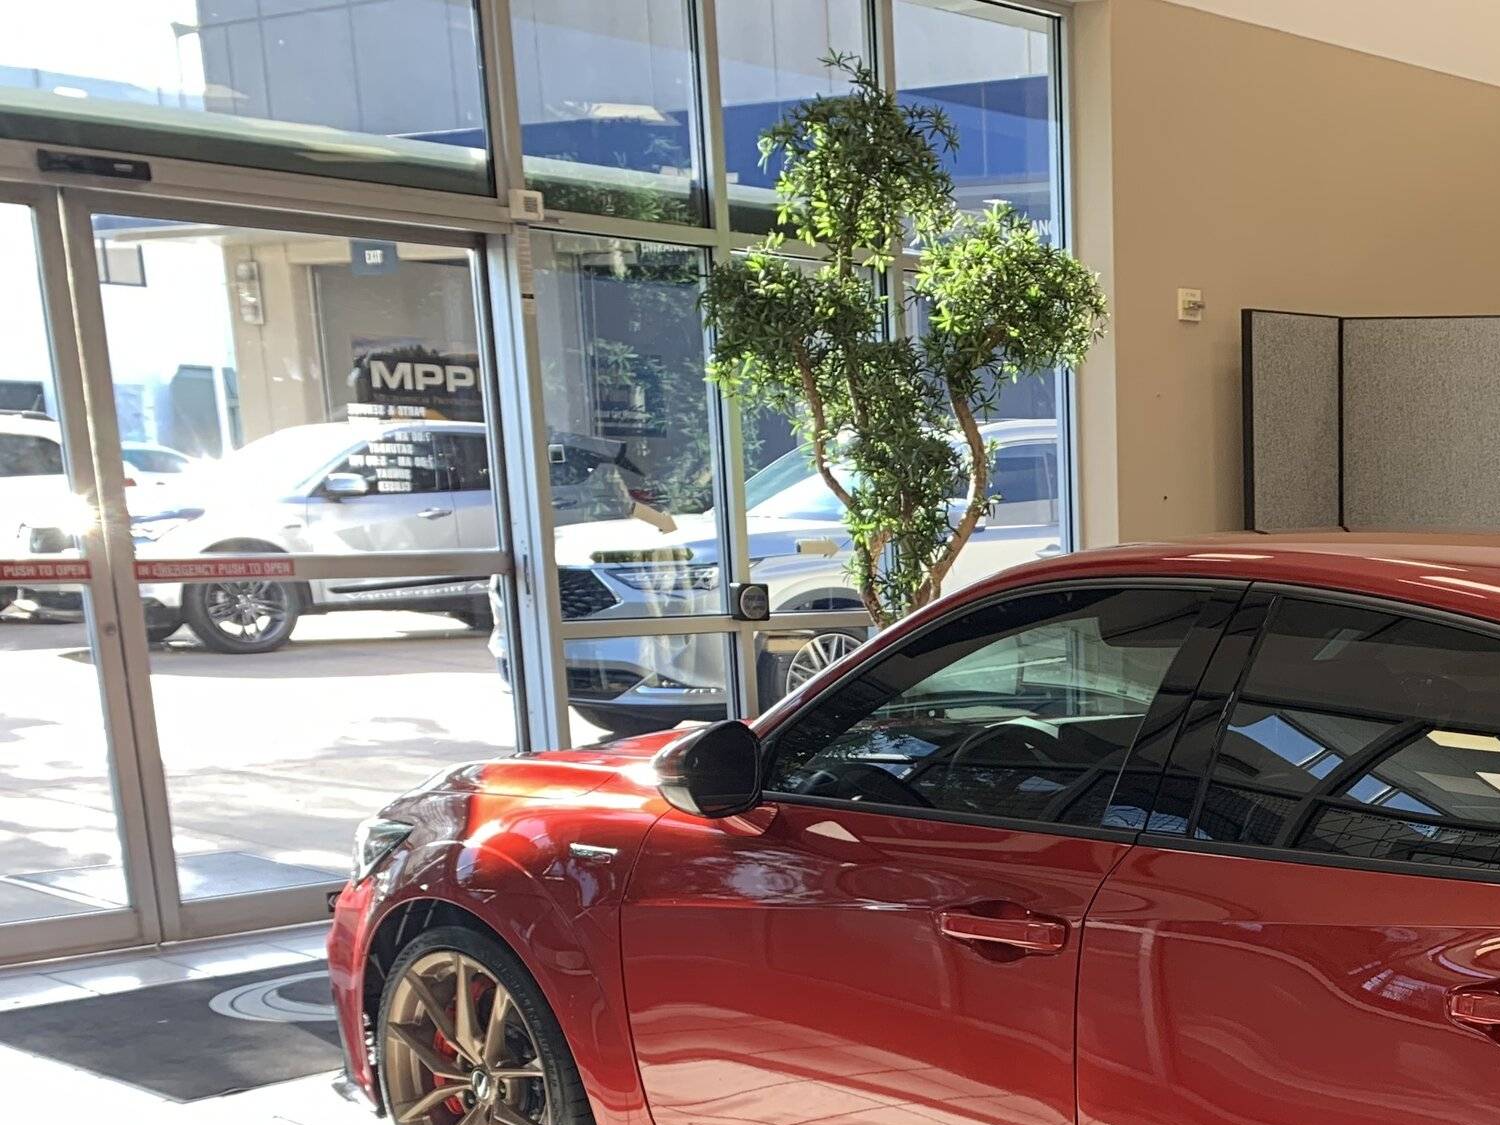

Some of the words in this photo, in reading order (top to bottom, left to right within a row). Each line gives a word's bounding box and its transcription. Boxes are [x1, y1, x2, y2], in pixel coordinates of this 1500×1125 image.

[3, 564, 35, 577] PUSH
[39, 564, 53, 576] TO
[219, 563, 245, 575] PUSH
[249, 563, 262, 574] TO
